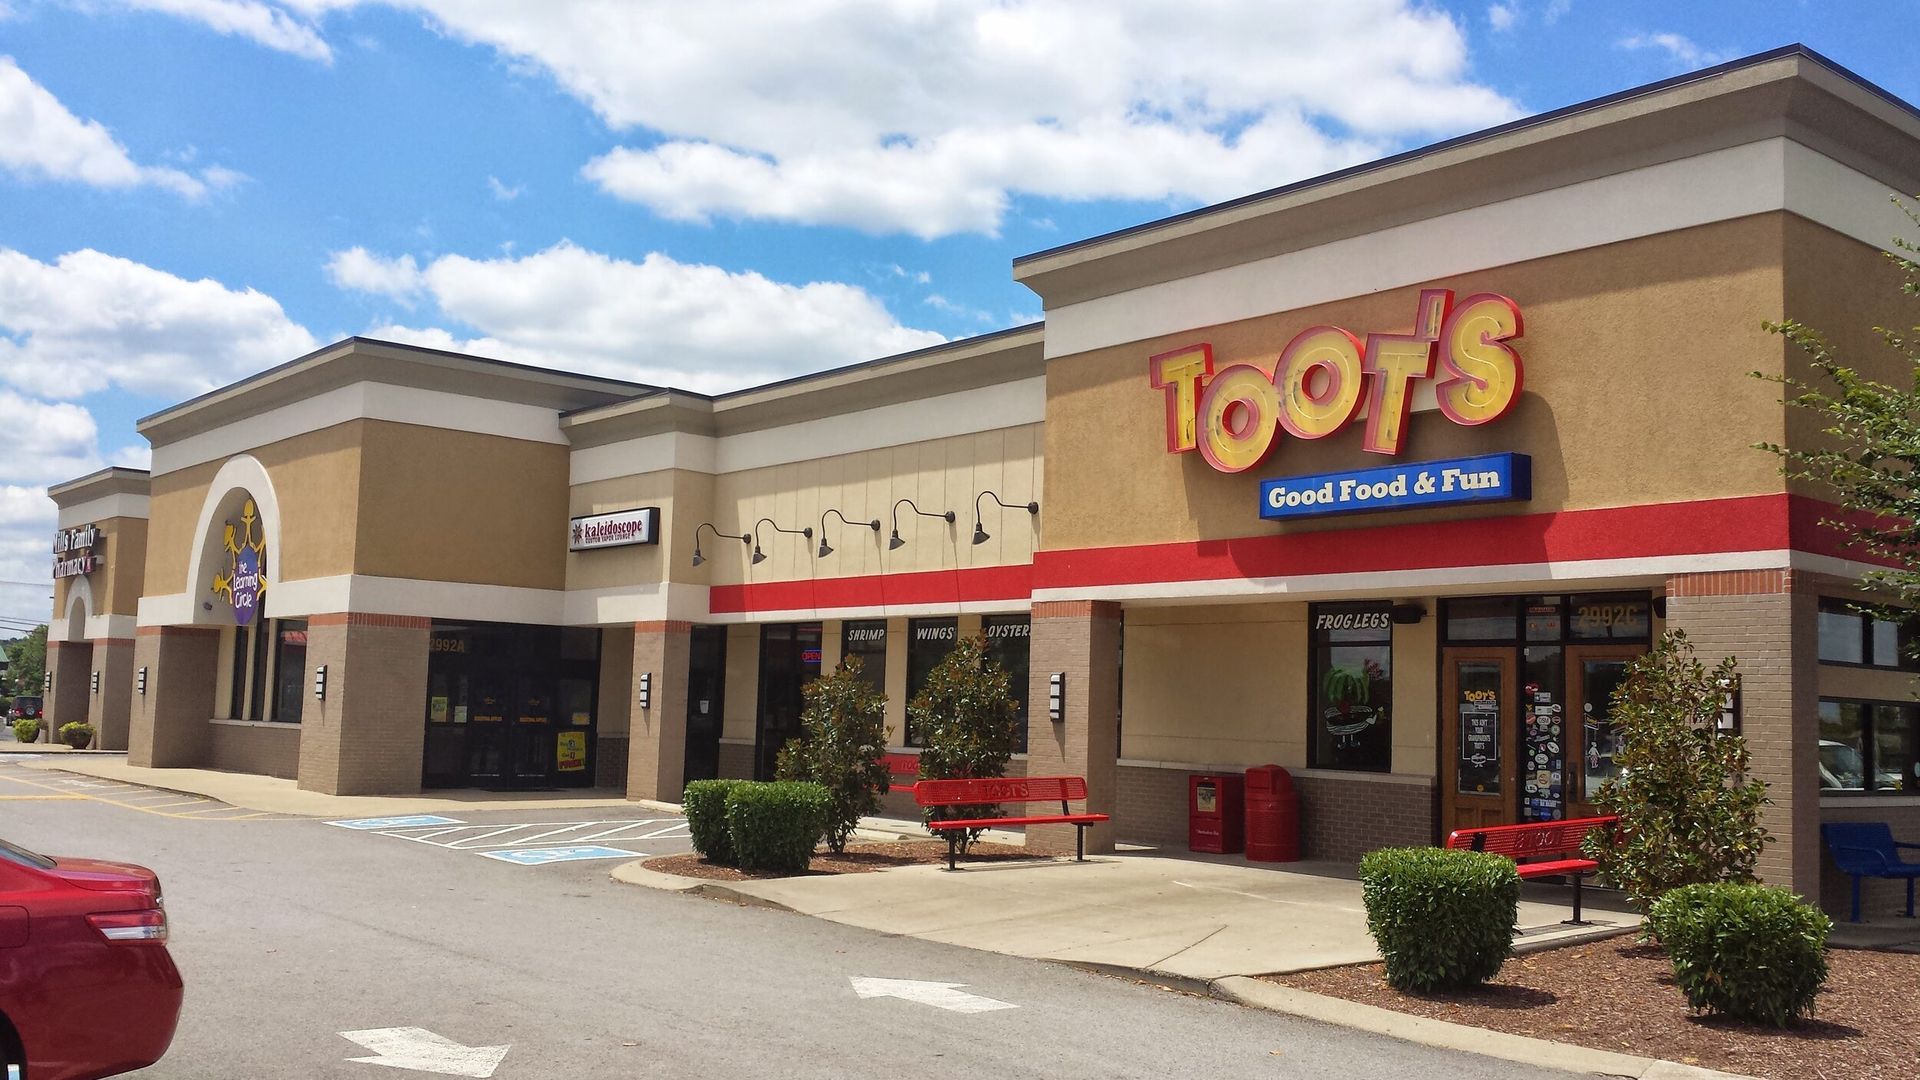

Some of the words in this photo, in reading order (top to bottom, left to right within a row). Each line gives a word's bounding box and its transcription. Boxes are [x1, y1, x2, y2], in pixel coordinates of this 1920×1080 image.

[1149, 289, 1524, 473] TOOT'S
[1268, 482, 1334, 508] Good
[1339, 475, 1407, 502] Food
[1413, 472, 1435, 493] &
[1441, 468, 1500, 492] Fun
[71, 524, 95, 550] Family
[585, 520, 642, 537] kaleidoscope
[233, 572, 257, 591] Learning
[235, 591, 252, 608] Circle
[1316, 614, 1352, 630] FROG
[1353, 613, 1389, 629] LEGS
[1578, 605, 1638, 627] 2992C
[848, 628, 885, 641] SHRIMP
[916, 626, 954, 640] WINGS
[430, 638, 464, 653] 2992A
[1464, 690, 1495, 701] TOOT'S
